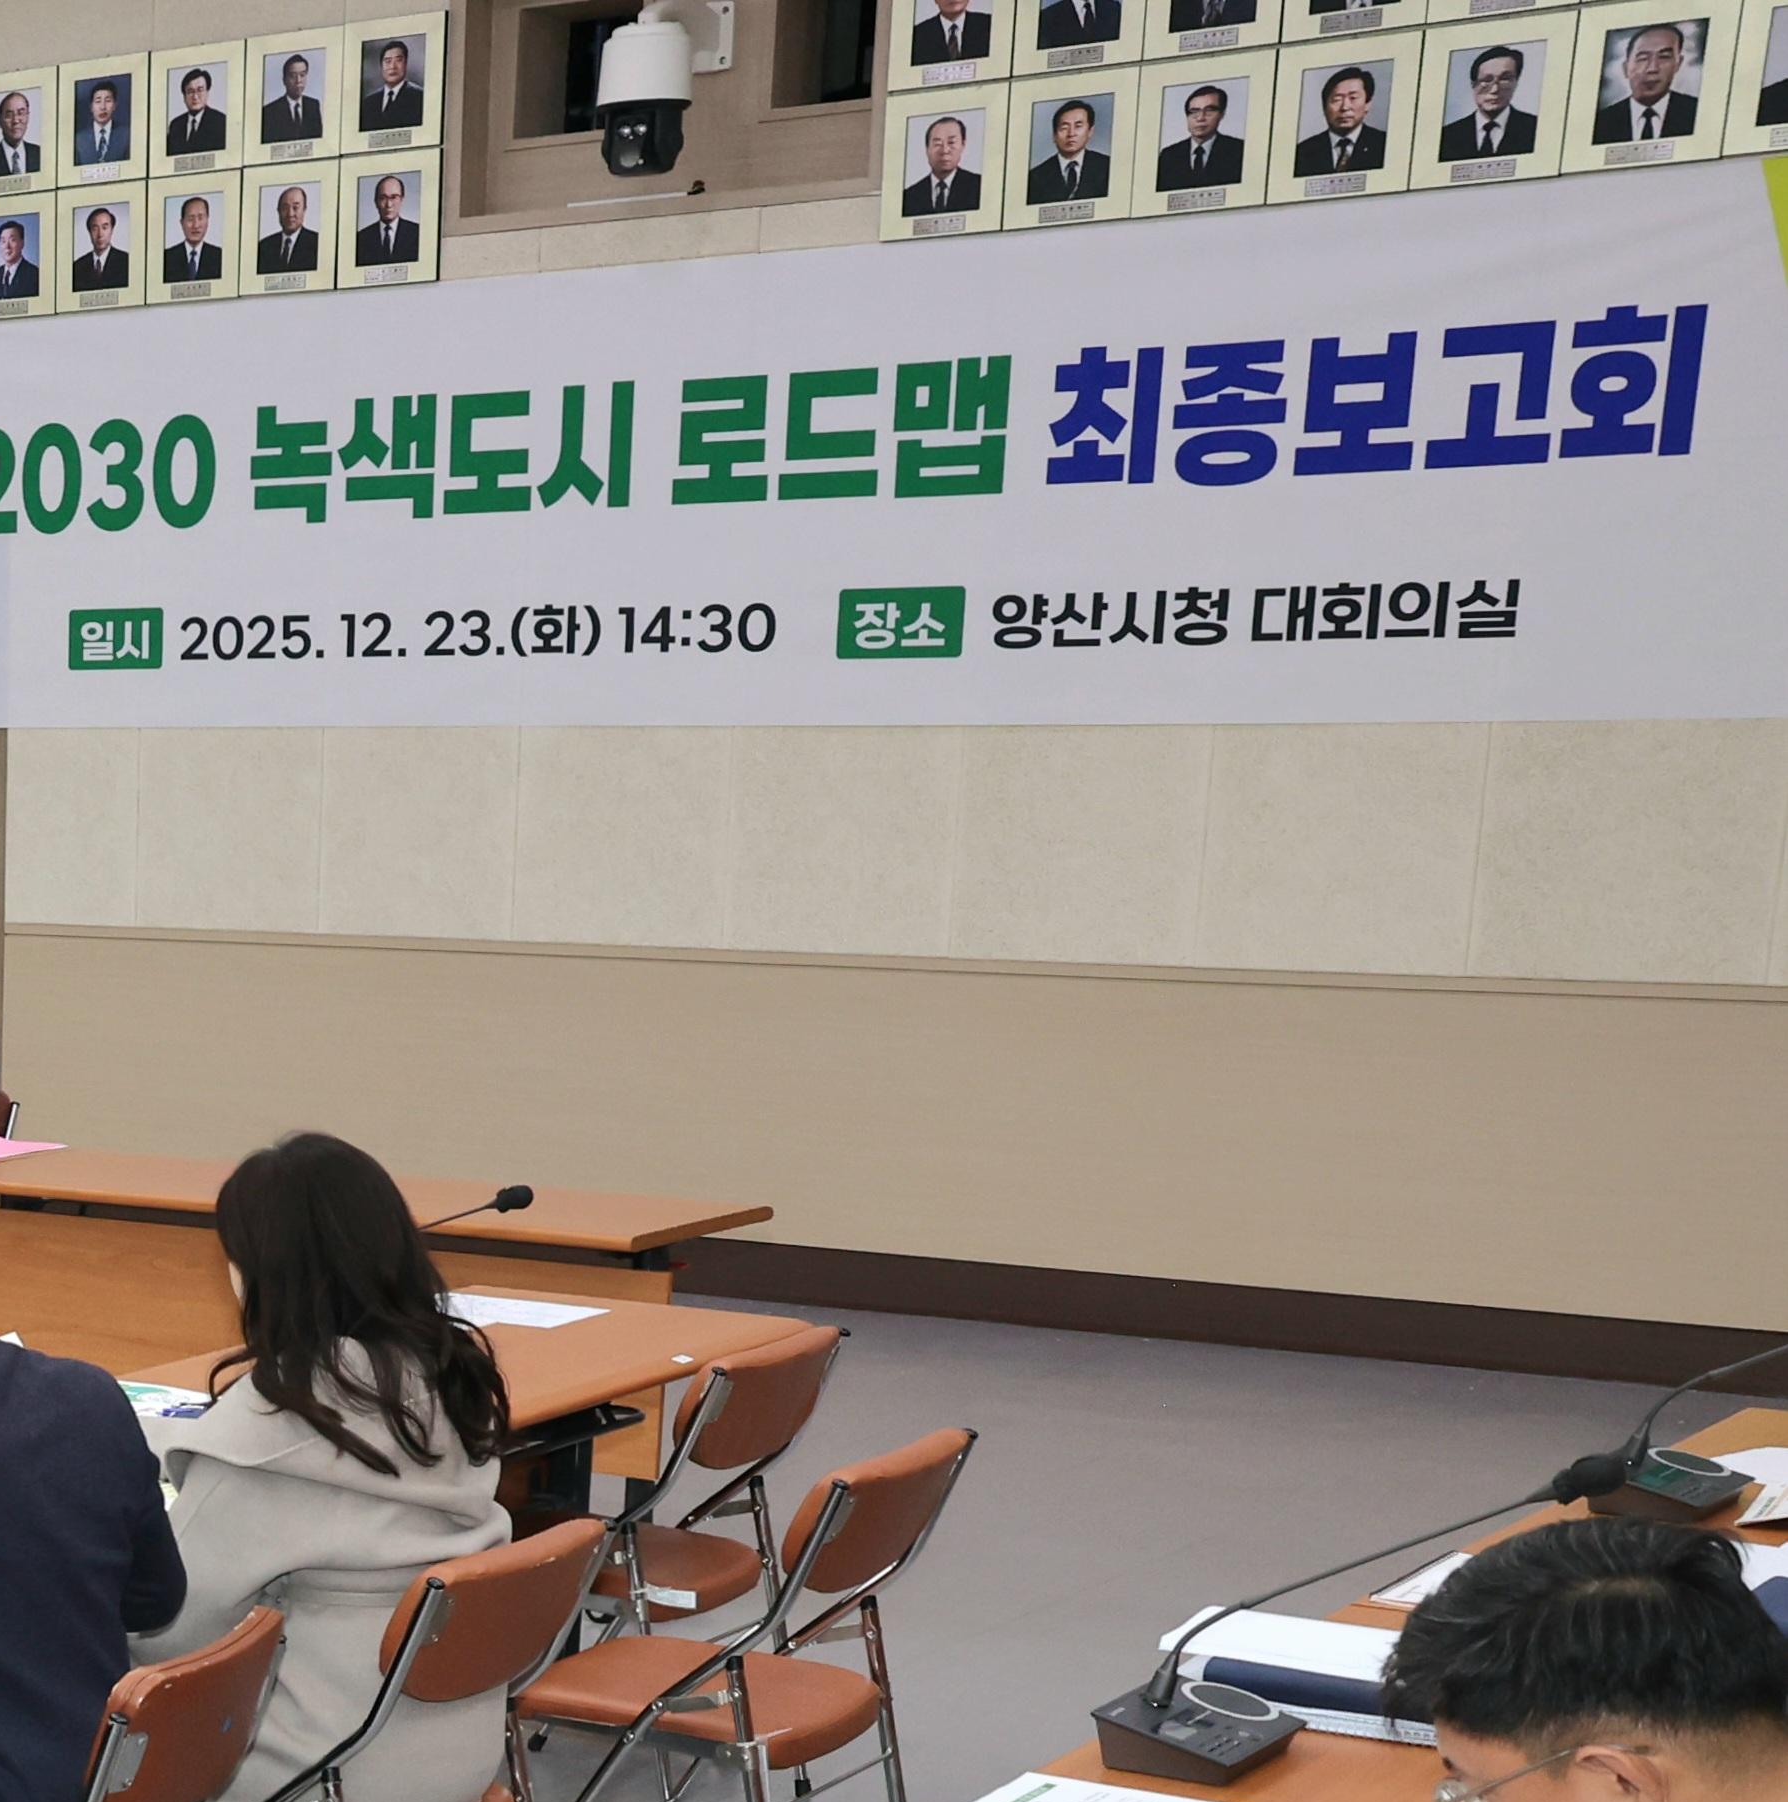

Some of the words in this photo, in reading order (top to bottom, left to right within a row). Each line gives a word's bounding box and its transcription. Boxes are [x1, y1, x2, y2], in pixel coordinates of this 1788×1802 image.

[251, 381, 634, 523] 녹색도시
[672, 355, 1011, 505] 로드맵
[1046, 304, 1708, 486] 최종보고회
[82, 621, 149, 660] 일시
[181, 615, 324, 660] 2025.
[341, 613, 406, 657] 12.
[424, 605, 600, 657] 23.(화)
[619, 603, 776, 653] 14:30
[855, 603, 944, 648] 장소
[993, 587, 1229, 649] 양산시청
[1252, 579, 1520, 641] 대회의실
